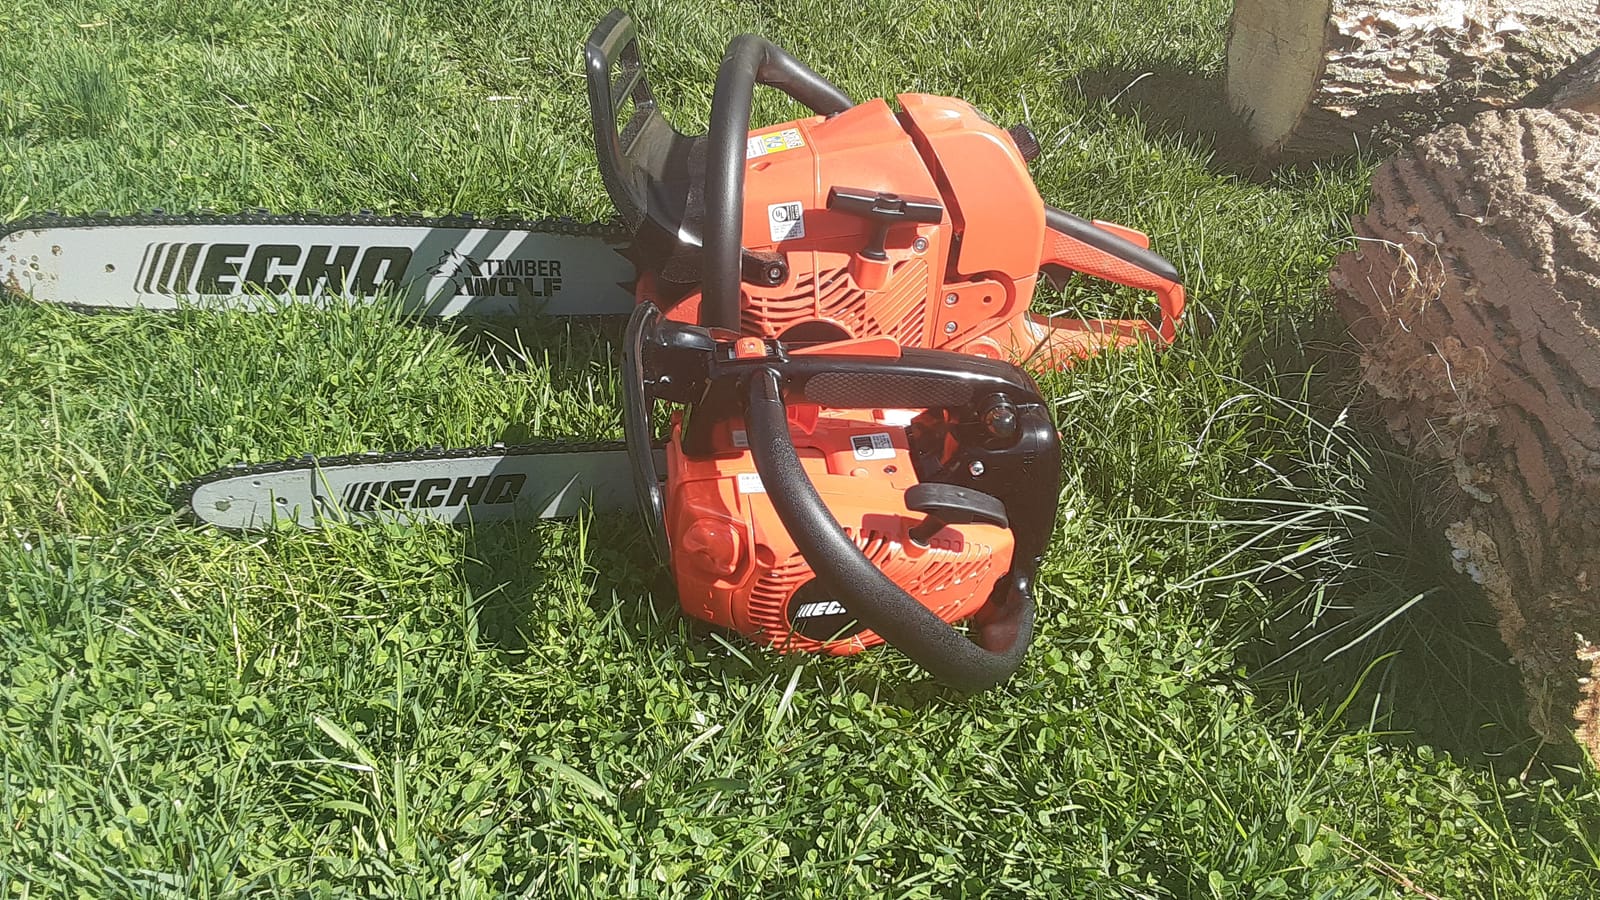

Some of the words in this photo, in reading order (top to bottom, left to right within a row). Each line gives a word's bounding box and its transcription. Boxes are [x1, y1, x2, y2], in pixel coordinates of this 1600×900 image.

[195, 243, 413, 297] ECHO
[482, 259, 562, 277] TIMBER
[464, 277, 562, 297] WOLF
[382, 473, 527, 510] ECHO
[812, 600, 847, 616] EC
